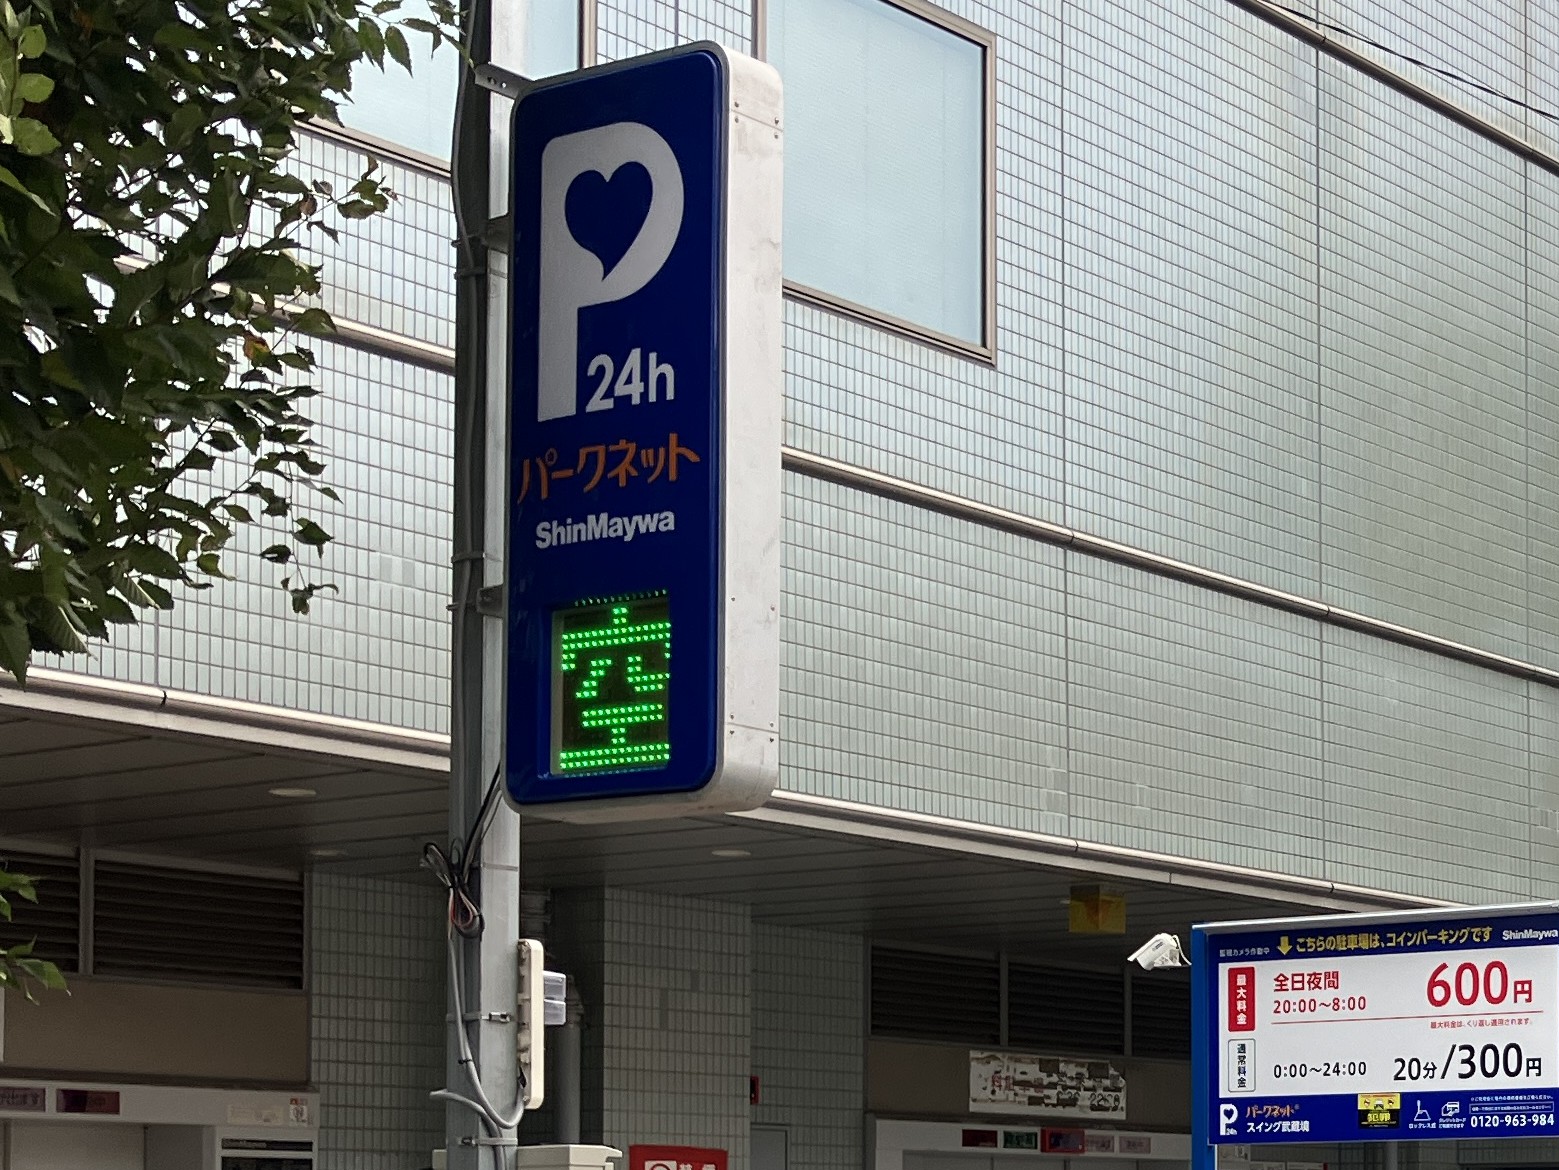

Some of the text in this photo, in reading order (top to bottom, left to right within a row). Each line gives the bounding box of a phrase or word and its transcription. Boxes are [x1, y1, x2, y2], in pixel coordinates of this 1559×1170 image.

[537, 122, 685, 422] P
[585, 347, 676, 413] 24h
[517, 432, 701, 504] パークネット
[535, 510, 675, 549] ShinMaywa
[560, 606, 671, 770] 空
[1296, 926, 1493, 953] こちらの駐車場は、コインパーキングです
[1502, 928, 1559, 941] ShinMaywa
[1236, 974, 1248, 1025] 最大料金
[1273, 970, 1340, 993] 全日夜間
[1426, 960, 1533, 1008] 600円
[1237, 1043, 1247, 1089] 通常料金
[1470, 1113, 1555, 1128] 0120-963-984
